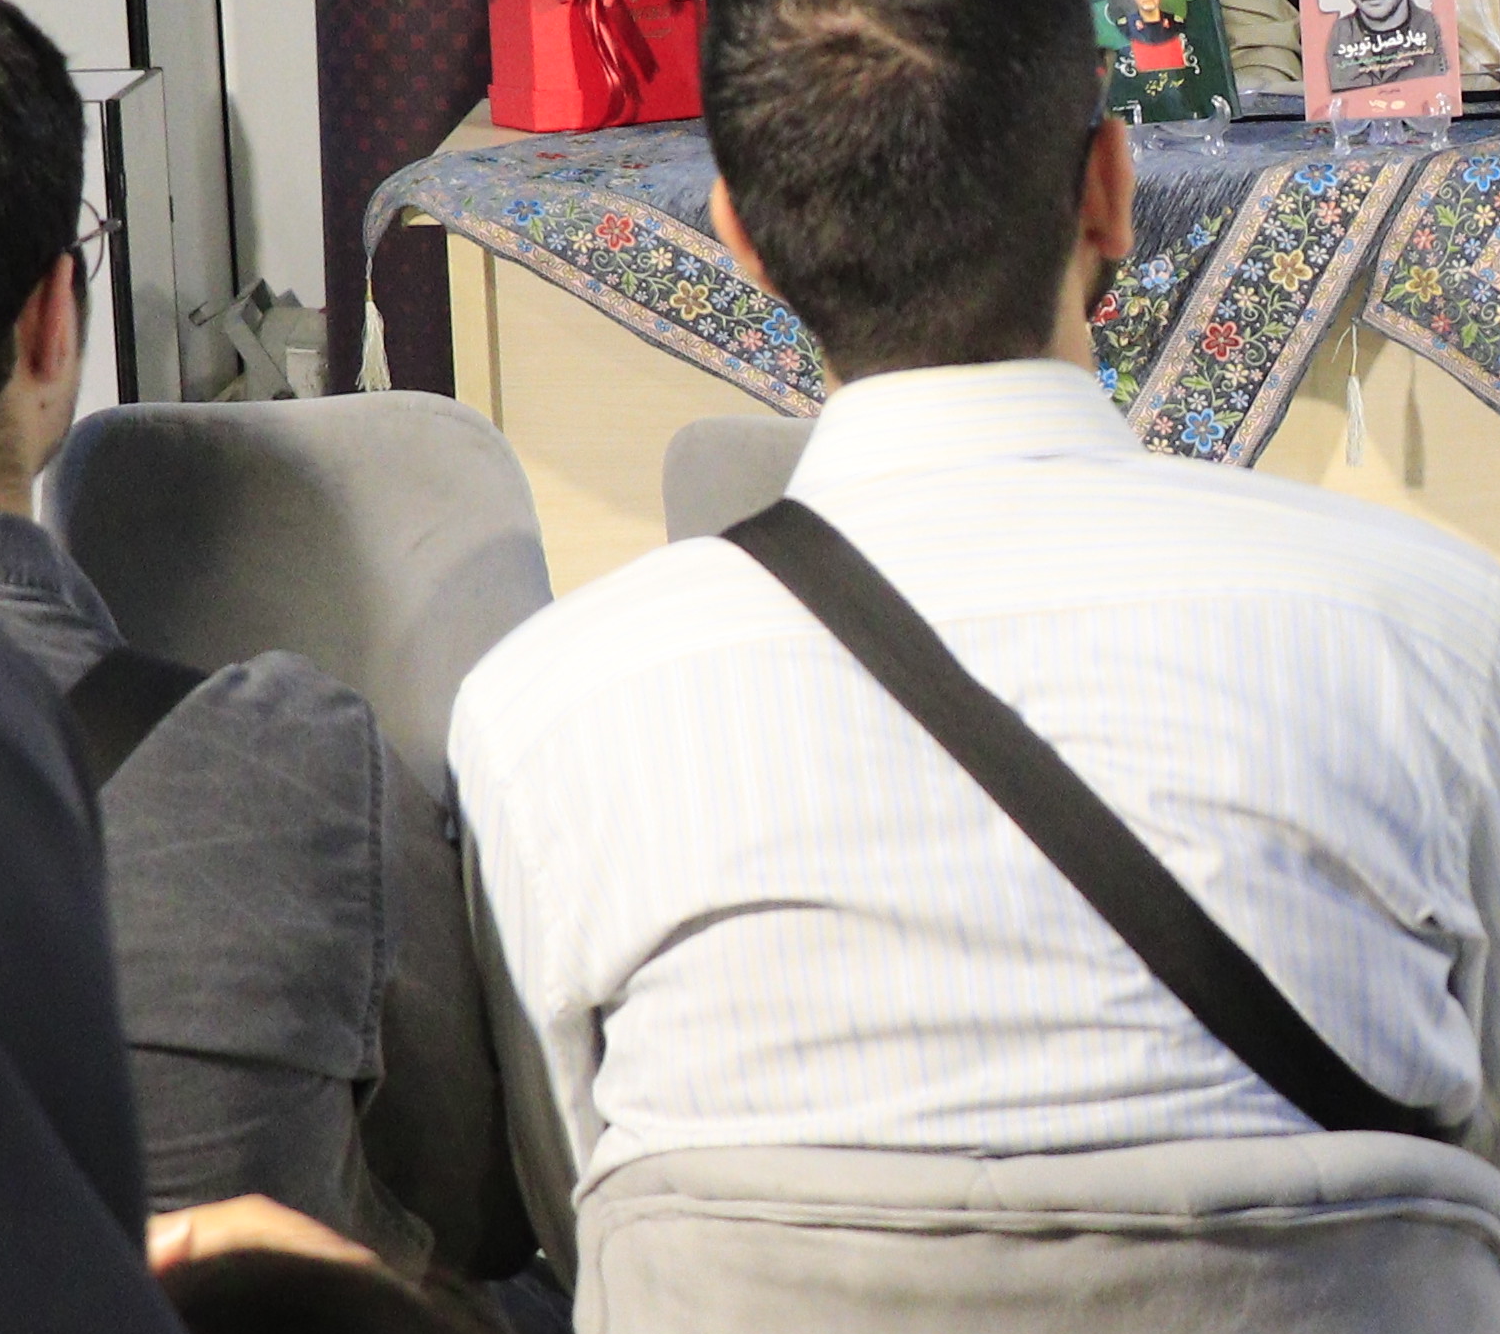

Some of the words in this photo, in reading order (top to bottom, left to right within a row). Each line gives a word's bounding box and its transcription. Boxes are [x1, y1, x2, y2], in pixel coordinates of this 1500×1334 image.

[1358, 36, 1372, 56] تو
[1371, 29, 1404, 53] فصل
[1402, 29, 1427, 47] بهار
[1337, 44, 1359, 58] بود
